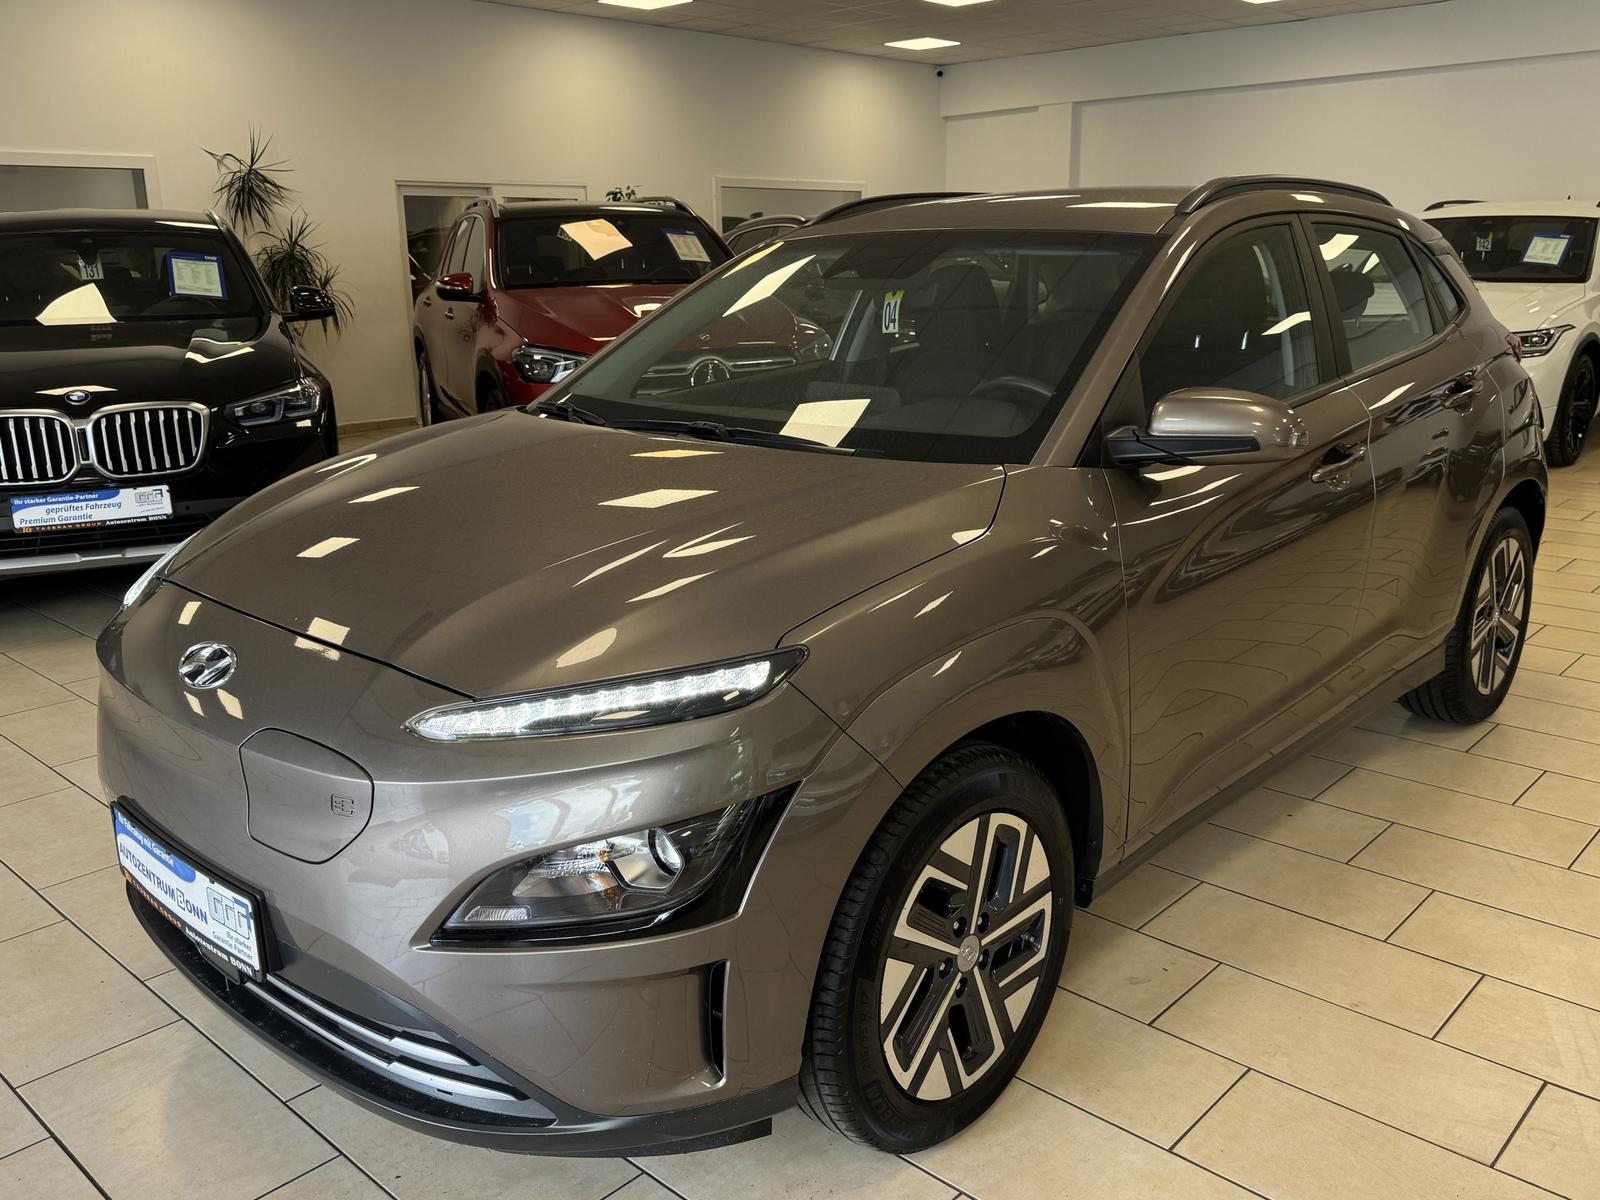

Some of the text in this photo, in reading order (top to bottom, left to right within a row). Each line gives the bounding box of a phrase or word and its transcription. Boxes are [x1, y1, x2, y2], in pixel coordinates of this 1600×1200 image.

[82, 263, 100, 278] 131
[884, 300, 898, 330] 04
[46, 494, 98, 503] Garantie-Partner
[45, 502, 122, 516] geprüftes Fahrzeug
[20, 513, 93, 525] Premium Garantie
[105, 518, 147, 526] Autozentrum
[185, 926, 253, 977] Autozentrum BONN
